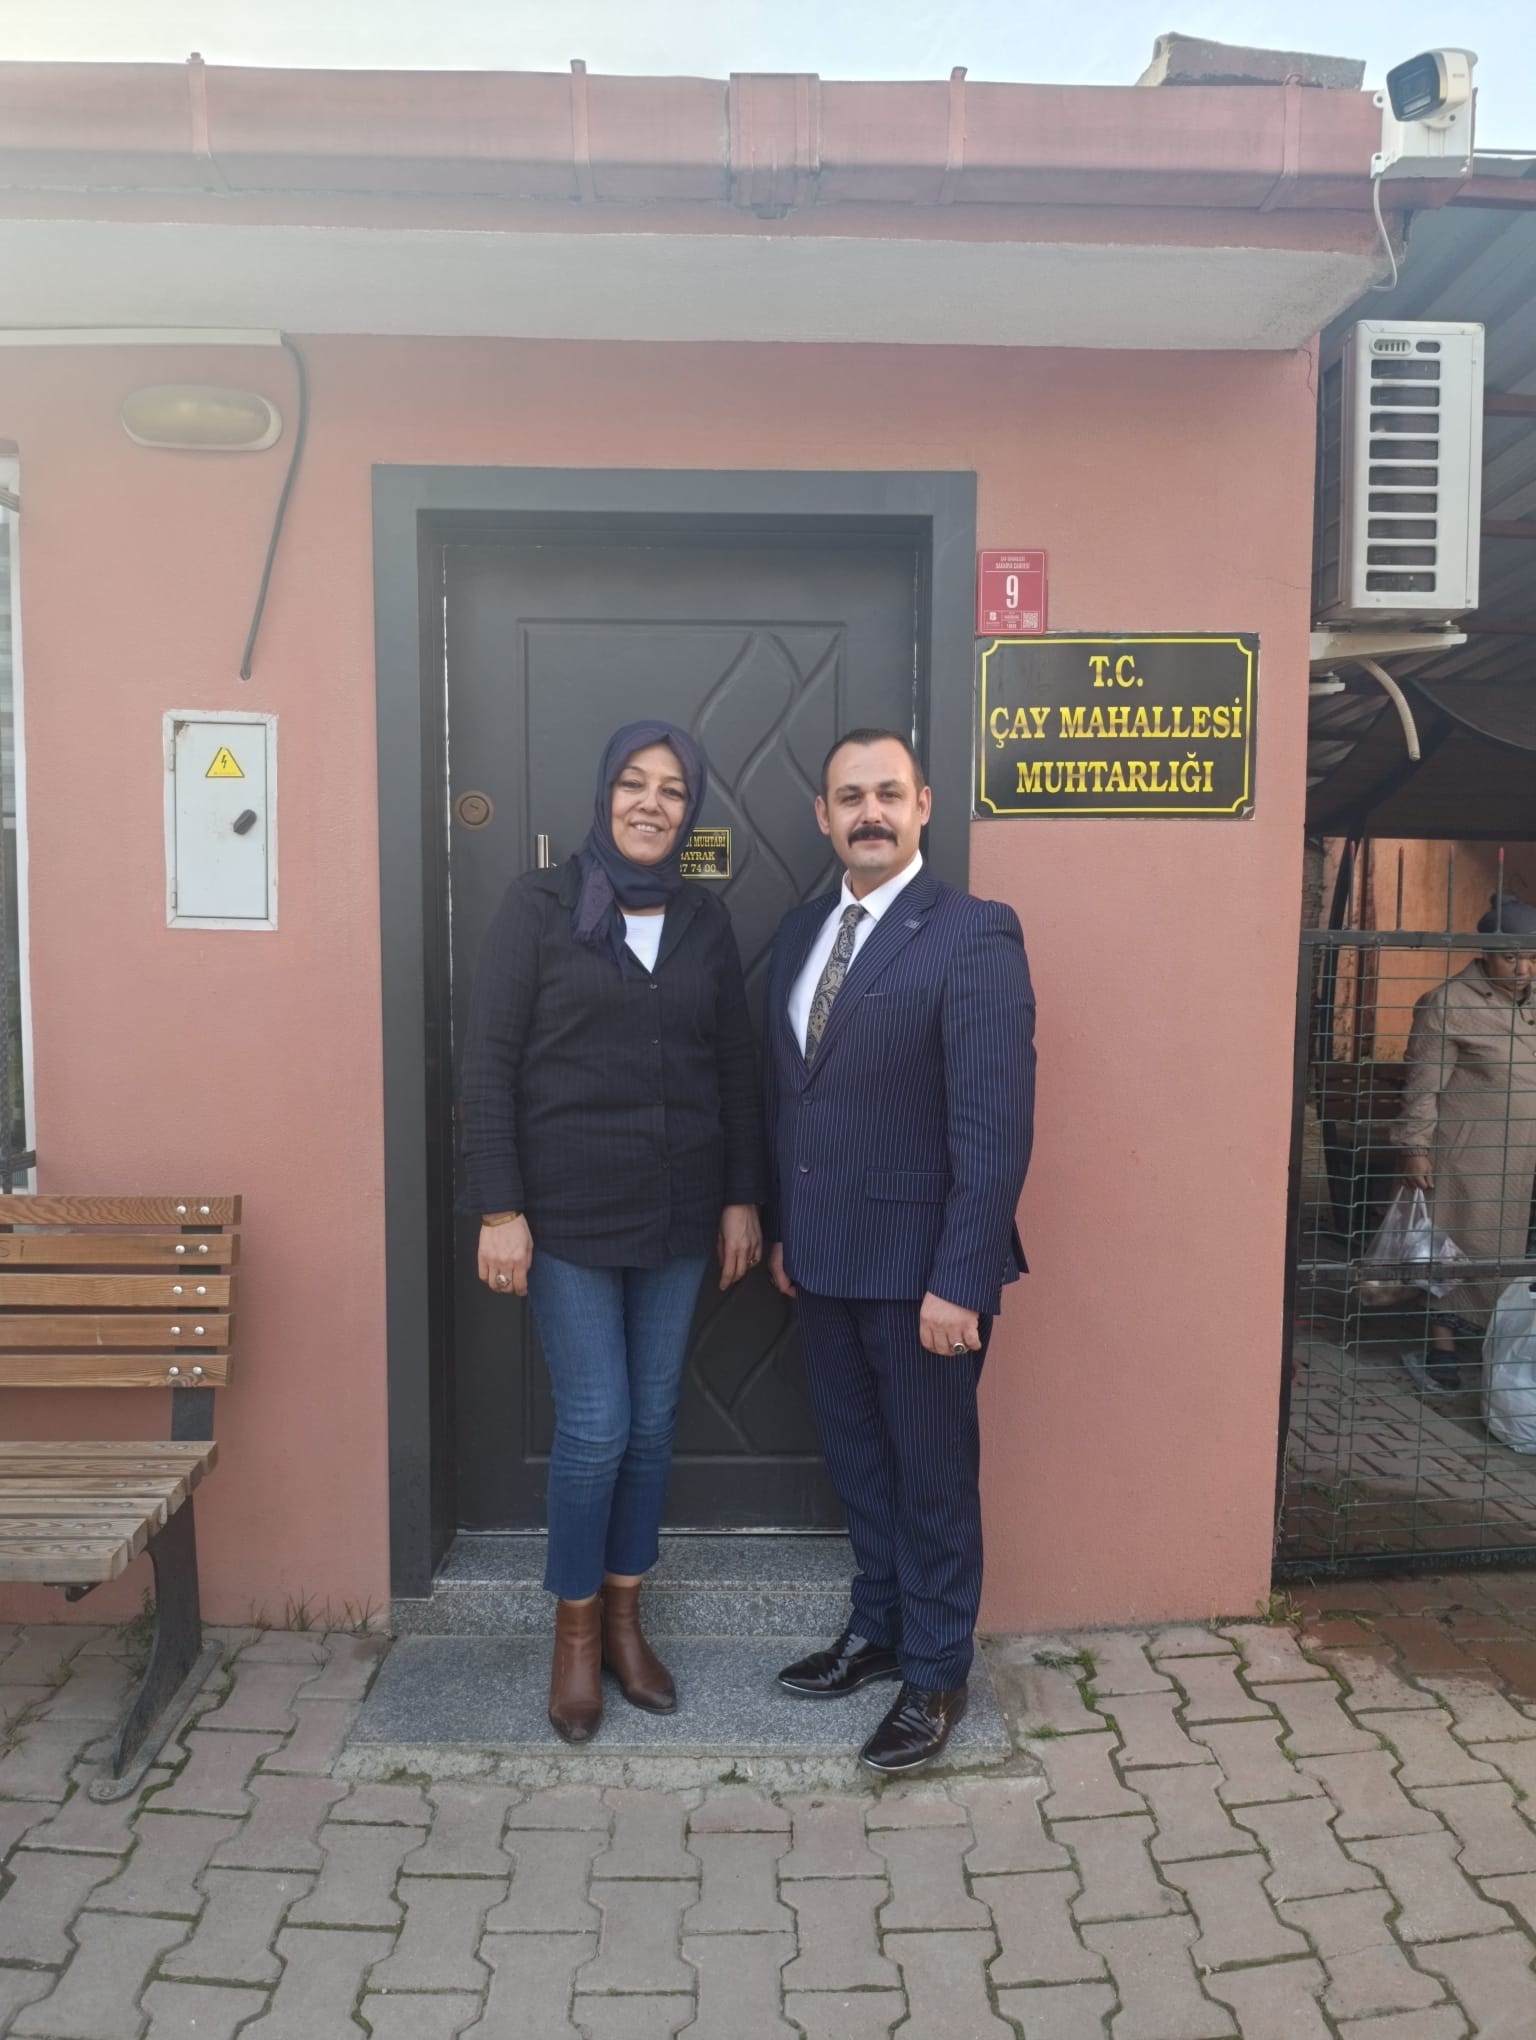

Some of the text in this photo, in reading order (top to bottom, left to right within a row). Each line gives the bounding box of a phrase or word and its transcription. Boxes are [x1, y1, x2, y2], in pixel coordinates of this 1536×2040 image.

[1006, 575, 1019, 609] 9
[1088, 655, 1144, 688] T.C.
[989, 697, 1243, 749] ÇAY MAHALLESİ
[1016, 751, 1214, 793] MUHTARLIĞI
[680, 864, 716, 873] 7 74 00
